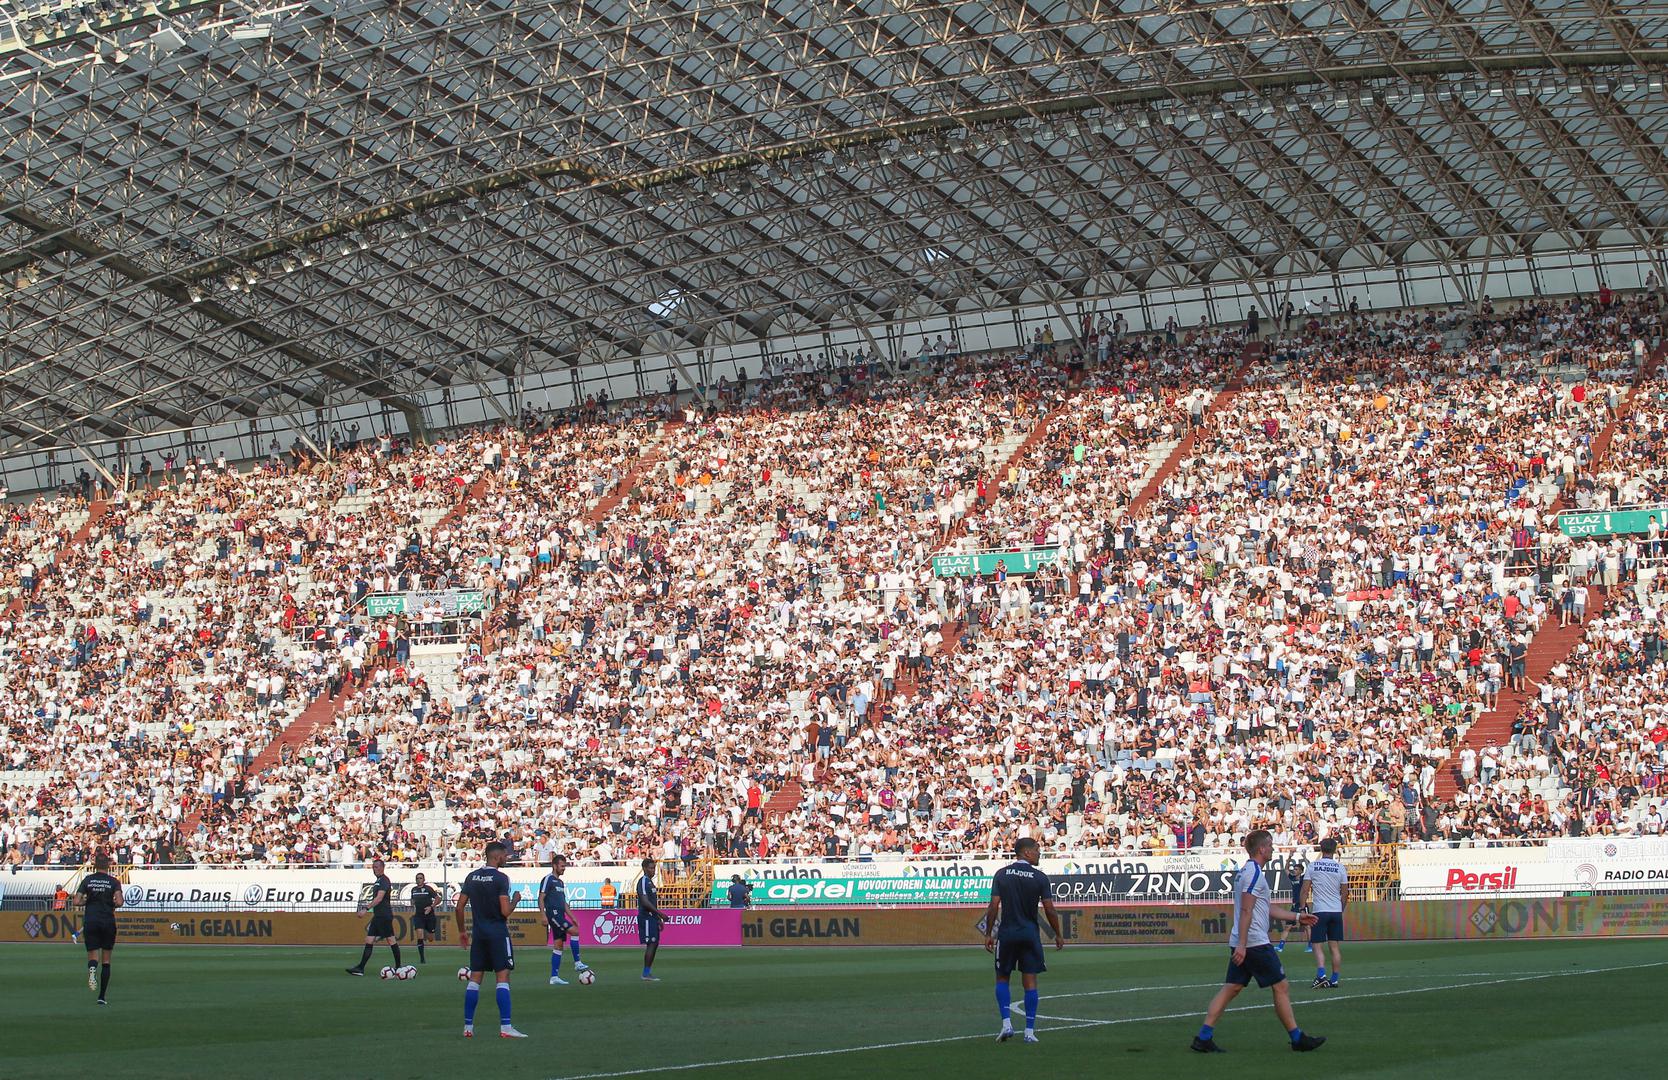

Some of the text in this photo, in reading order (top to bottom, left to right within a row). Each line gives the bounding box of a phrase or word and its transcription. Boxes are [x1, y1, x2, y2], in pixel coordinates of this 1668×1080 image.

[1563, 516, 1600, 524] IZLAZ
[1569, 525, 1597, 534] EXIT
[937, 557, 970, 566] IZLAZ
[1032, 550, 1058, 560] IZLA
[942, 566, 967, 575] EXIT
[375, 606, 397, 614] EXIT
[764, 866, 822, 880] rudan
[923, 863, 984, 877] rudan
[1006, 868, 1034, 878] HAJDUK
[1085, 859, 1148, 875] rudan
[1446, 866, 1517, 891] Persil
[1605, 870, 1668, 880] RADIO DAL
[858, 877, 993, 890] NOVOOTVORENI SALON U SPLITU
[1050, 881, 1113, 898] TORAN
[1126, 873, 1210, 896] ZRNO
[146, 889, 184, 902] Euro
[190, 889, 232, 902] Daus
[266, 888, 305, 902] Euro
[310, 888, 354, 902] Daus
[768, 881, 853, 902] apfel
[615, 915, 639, 925] HRVA
[1201, 912, 1226, 934] mi
[201, 919, 272, 937] GEALAN
[613, 926, 636, 935] PRVA
[741, 918, 860, 938] mi GEALAN
